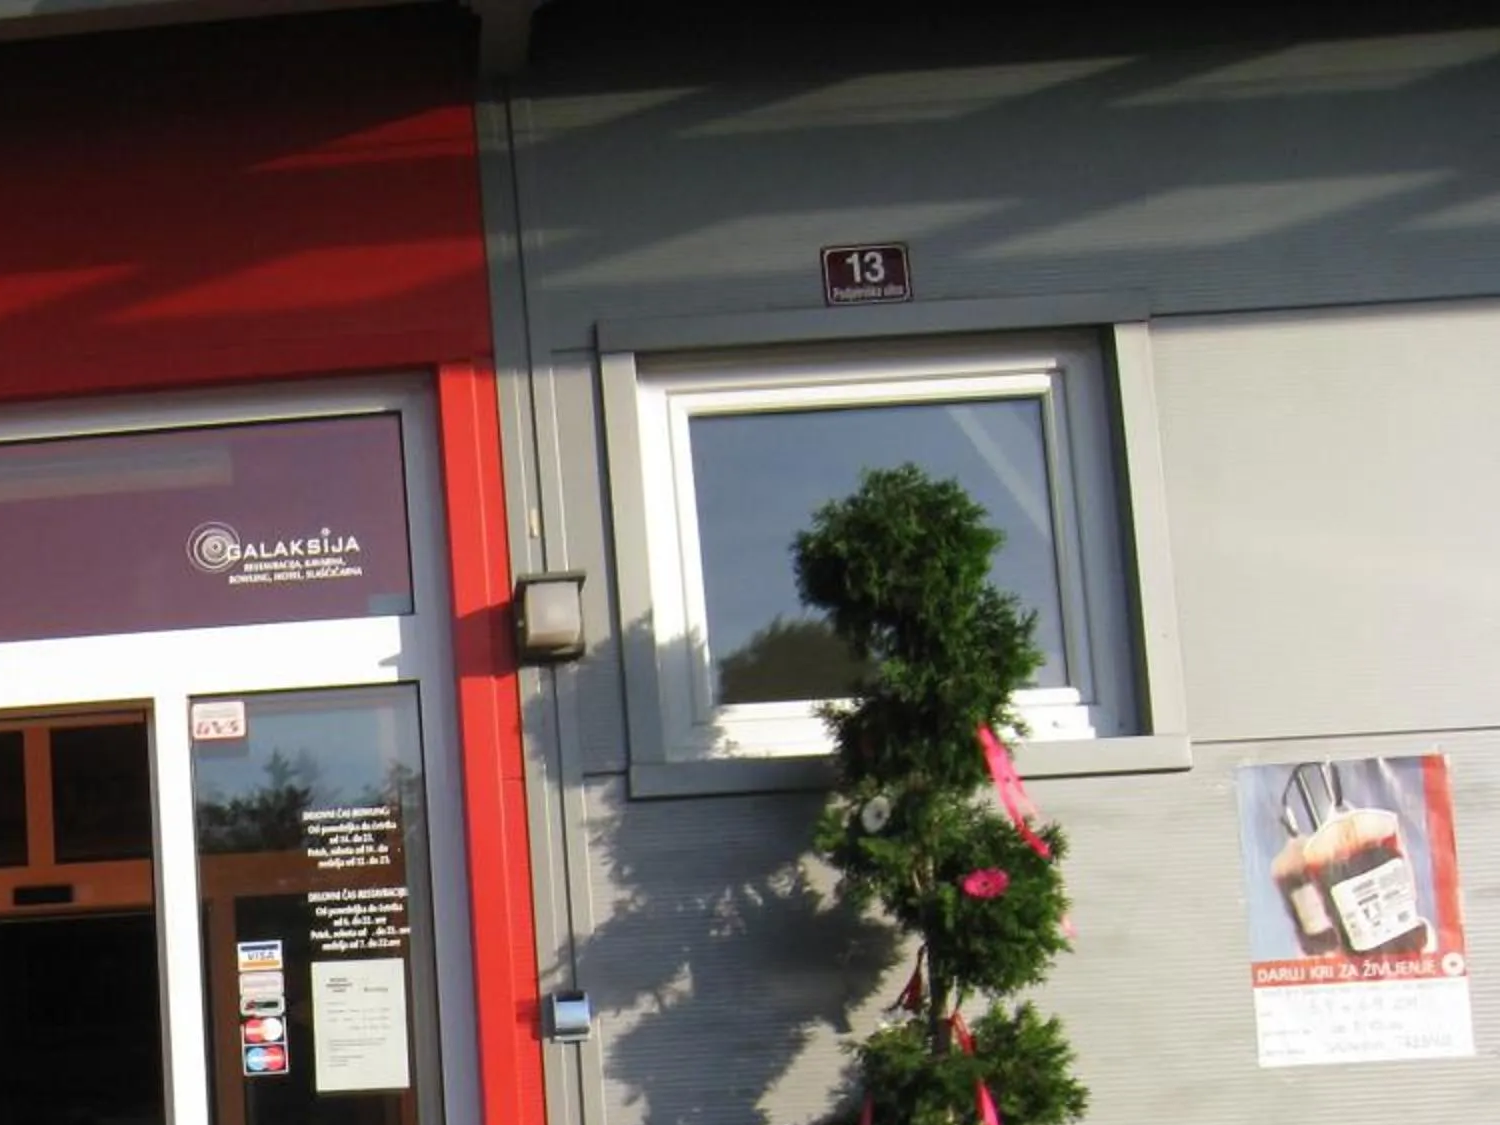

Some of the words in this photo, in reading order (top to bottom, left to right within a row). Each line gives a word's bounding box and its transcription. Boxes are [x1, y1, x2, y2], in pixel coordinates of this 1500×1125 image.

[846, 251, 885, 283] 13
[227, 527, 360, 561] GALAKSIJA
[247, 950, 275, 961] VISA
[1257, 966, 1305, 983] DARUJ
[1310, 965, 1334, 979] KRI
[1339, 963, 1359, 978] ZA
[1363, 959, 1437, 978] ŽIVLJENJE
